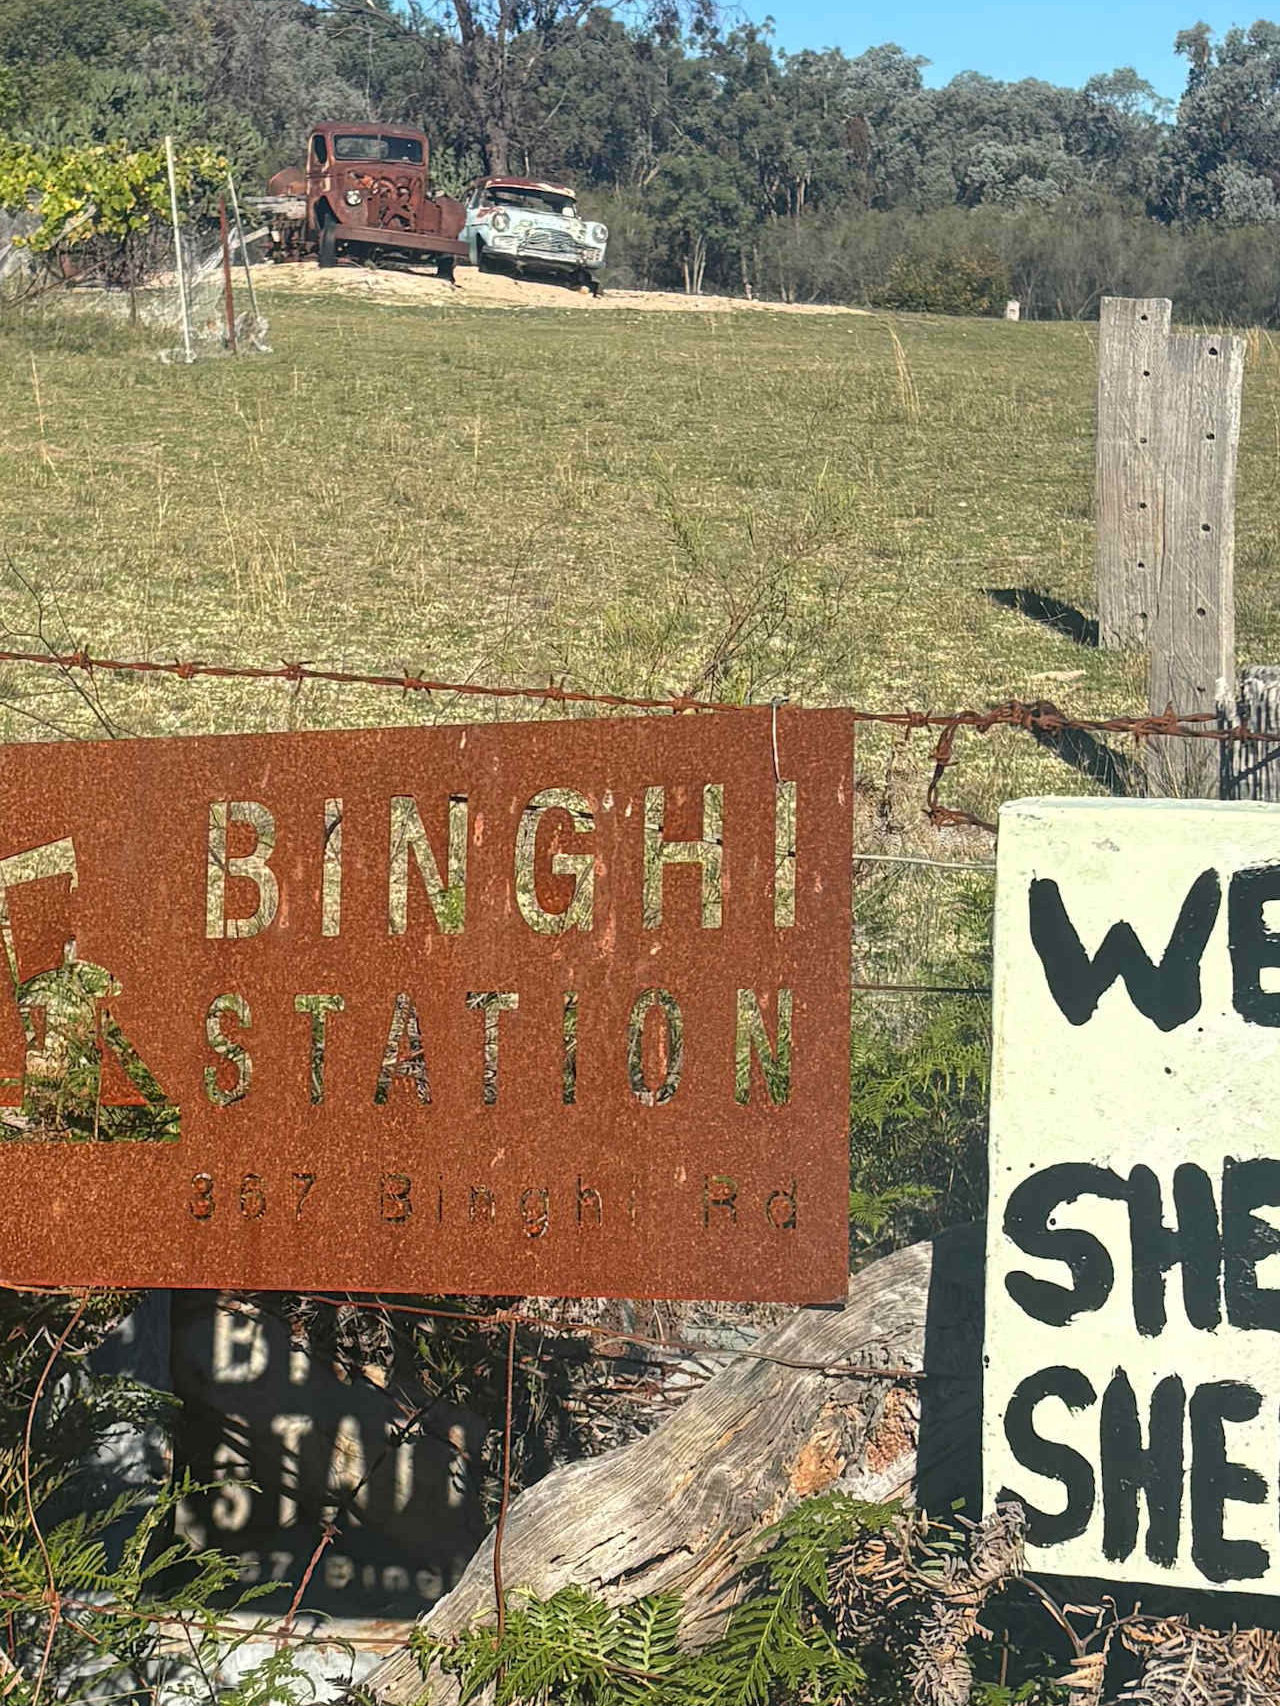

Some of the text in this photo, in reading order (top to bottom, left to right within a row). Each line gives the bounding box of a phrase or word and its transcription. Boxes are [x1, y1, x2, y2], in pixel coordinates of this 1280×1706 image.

[205, 781, 797, 940] BINGHI
[203, 987, 794, 1107] STATION
[379, 1172, 638, 1239] Binghi
[703, 1173, 797, 1230] Rd
